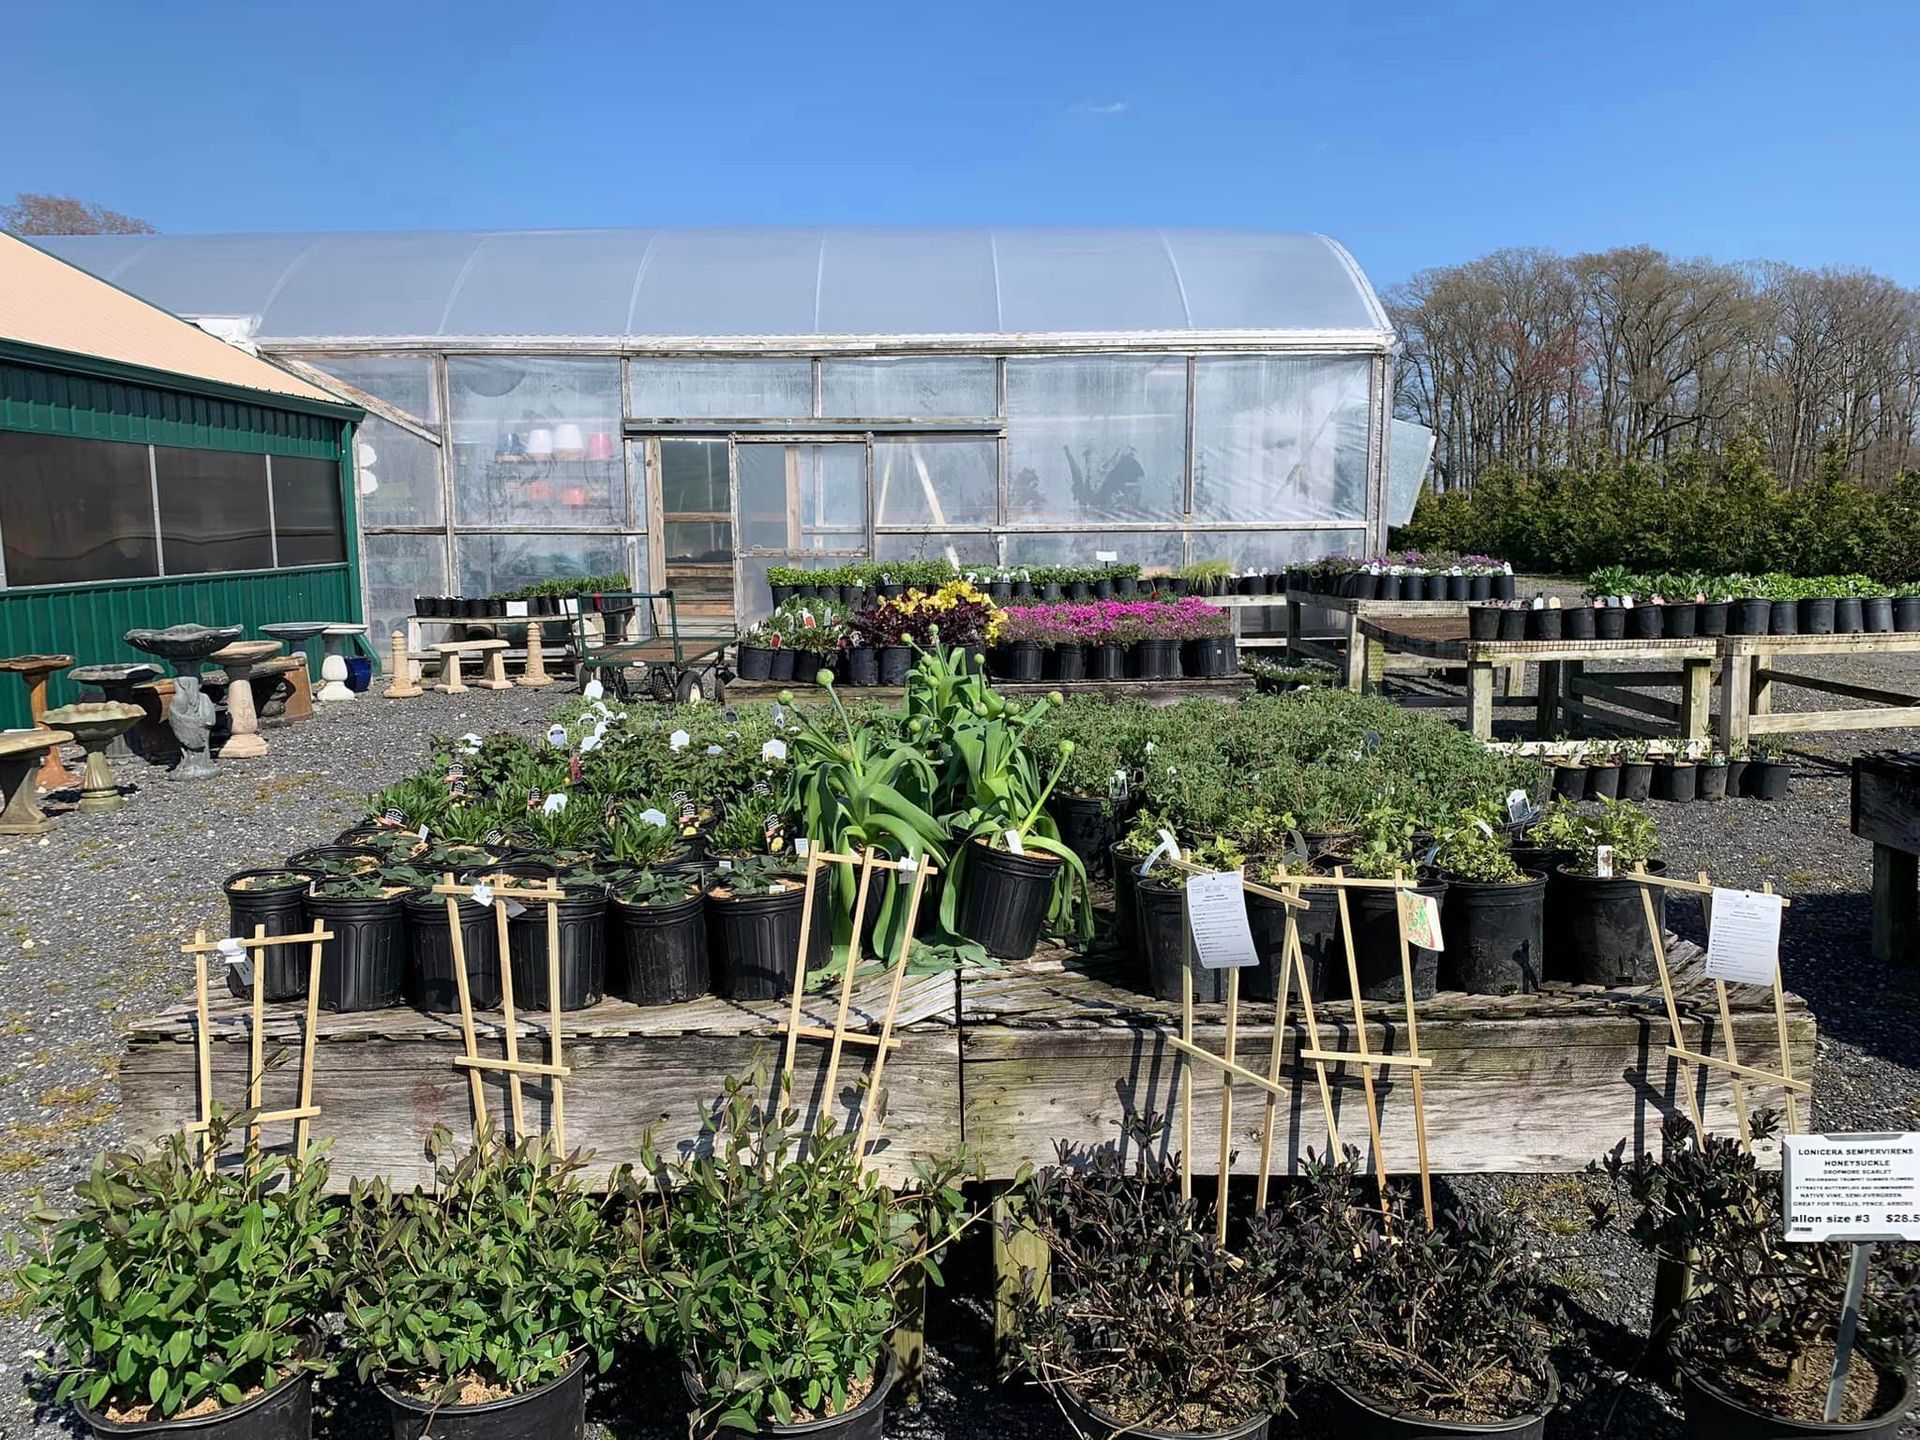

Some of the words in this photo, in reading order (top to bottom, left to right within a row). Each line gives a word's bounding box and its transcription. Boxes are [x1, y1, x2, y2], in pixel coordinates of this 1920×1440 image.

[1798, 1148, 1843, 1156] LONICERA
[1826, 1214, 1851, 1223] size
[1855, 1214, 1870, 1223] #3
